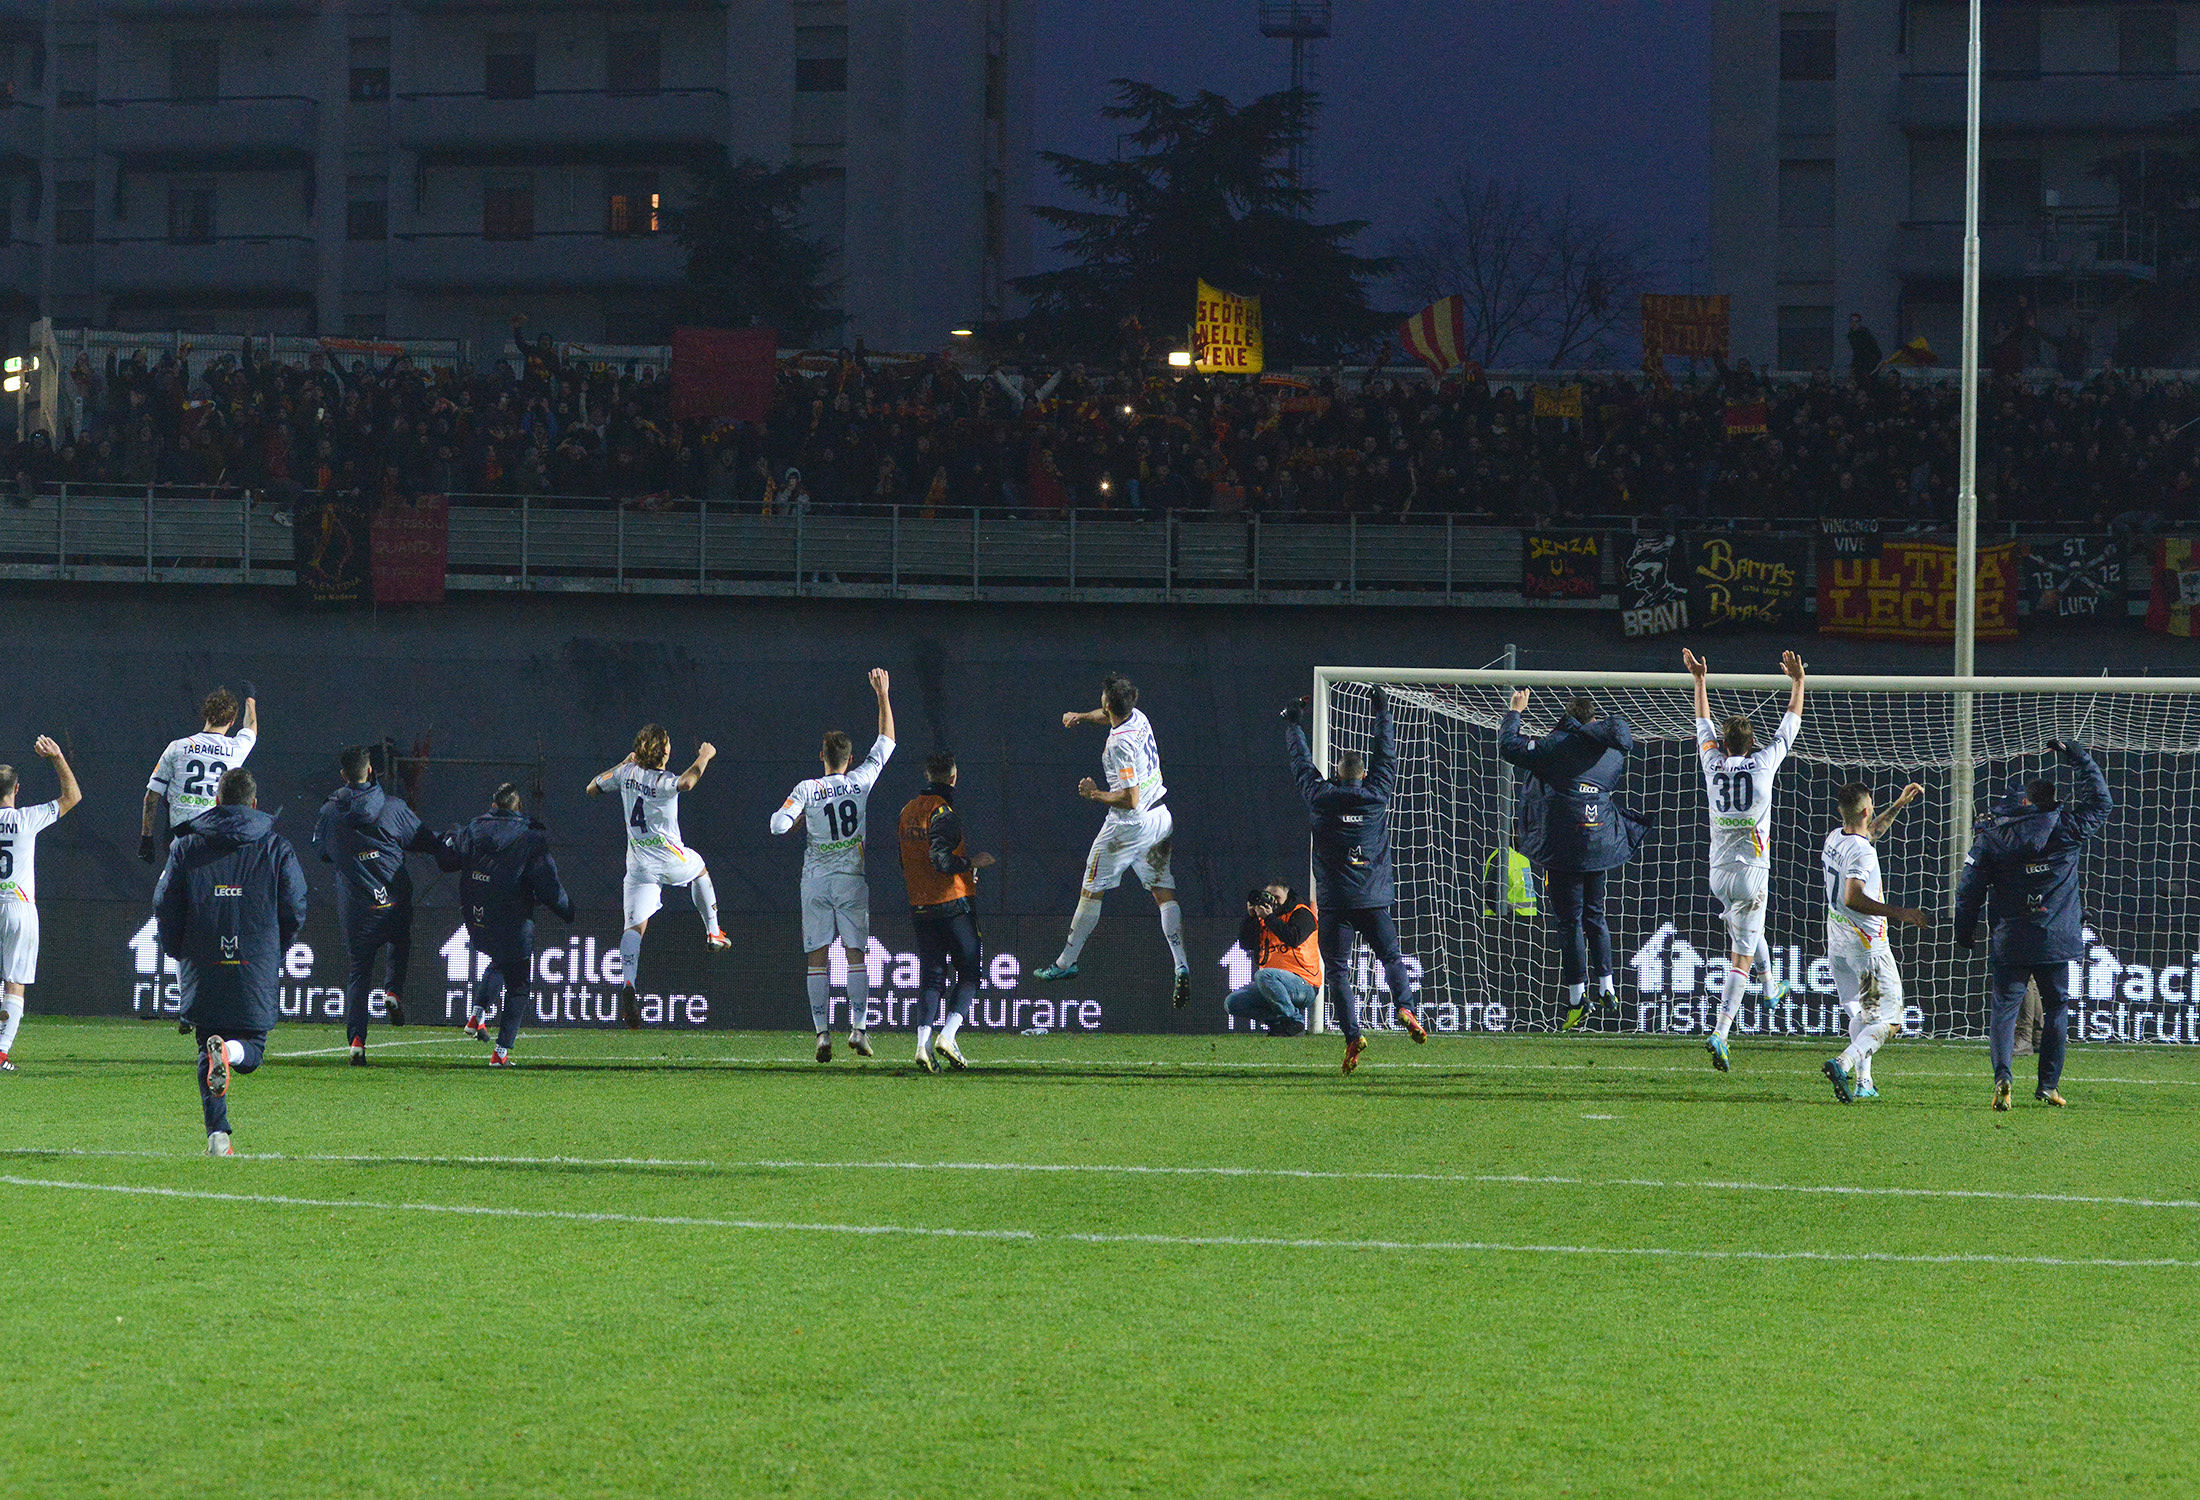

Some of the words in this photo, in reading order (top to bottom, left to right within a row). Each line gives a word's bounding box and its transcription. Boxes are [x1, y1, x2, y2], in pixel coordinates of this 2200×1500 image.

[1199, 324, 1254, 348] NELLE
[1202, 346, 1248, 367] VENE
[1529, 536, 1598, 559] SENZA
[1622, 600, 1689, 637] BRAVI
[1829, 589, 2005, 630] LECCE
[2058, 594, 2099, 616] LUCY
[183, 744, 234, 757] TABANELLI
[184, 759, 228, 797] 23
[1712, 771, 1754, 812] 30
[630, 796, 648, 834] 4
[823, 799, 858, 841] 18
[214, 887, 243, 896] LECCE
[2068, 1001, 2200, 1042] istrut
